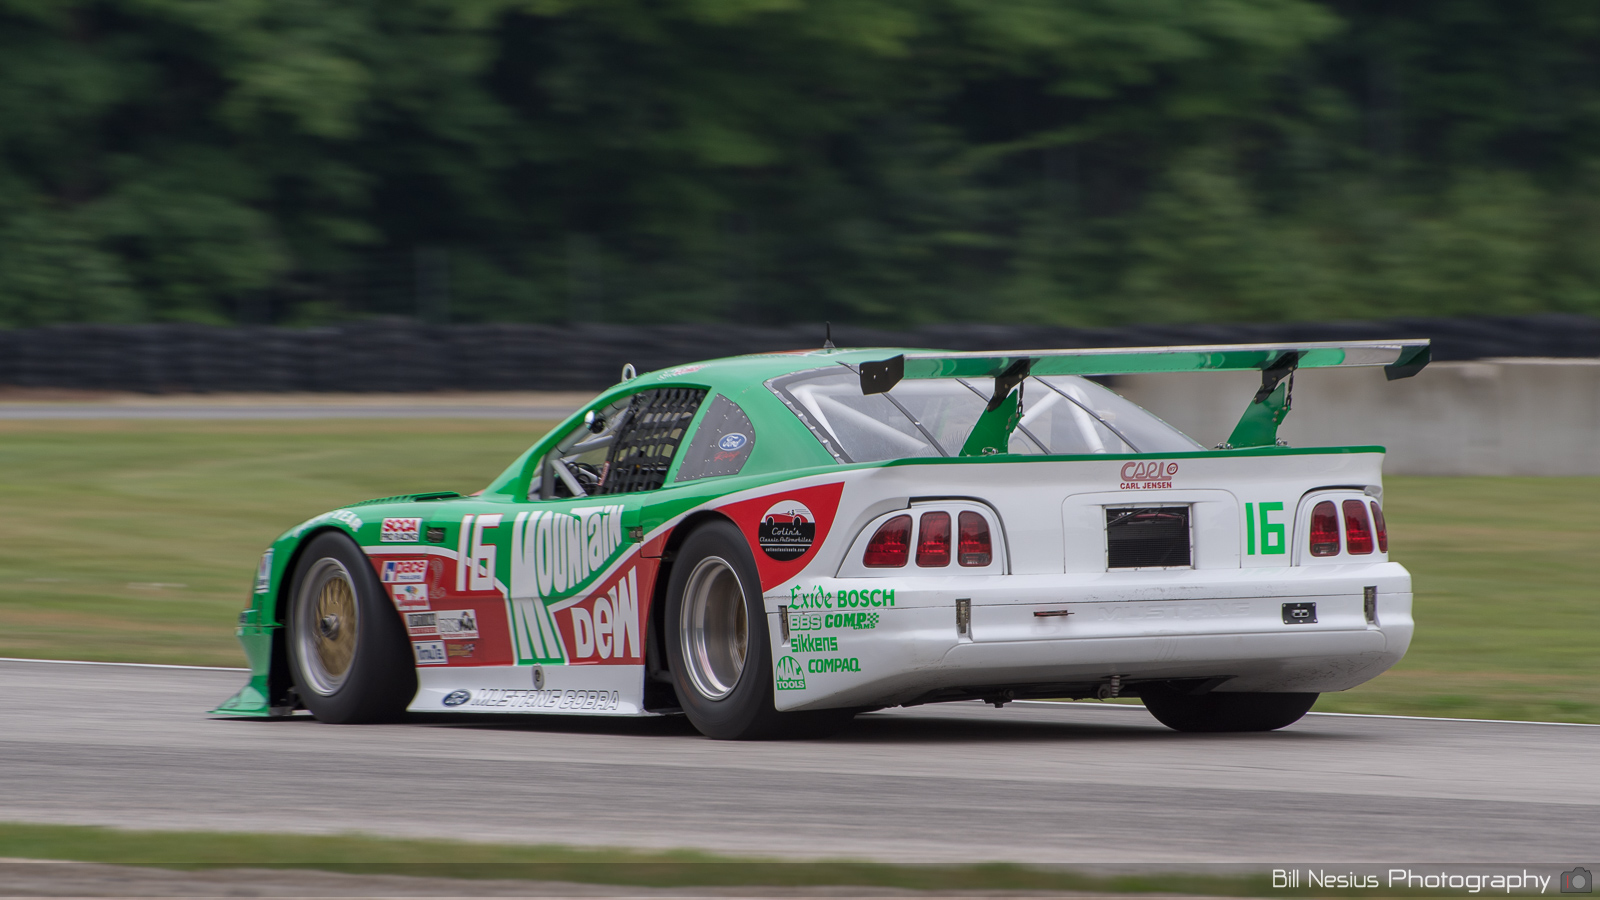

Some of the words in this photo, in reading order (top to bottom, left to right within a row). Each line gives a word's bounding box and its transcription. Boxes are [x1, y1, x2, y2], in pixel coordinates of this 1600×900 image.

[1120, 462, 1172, 481] CARL
[1120, 482, 1140, 490] CARL
[1142, 481, 1172, 489] JENSEN
[384, 519, 418, 532] SCCA
[771, 527, 802, 536] Colin's
[1245, 502, 1286, 555] 16
[456, 513, 503, 591] 16
[788, 584, 832, 610] Exide
[837, 589, 895, 608] BOSCH
[790, 614, 821, 631] BBS
[825, 613, 866, 628] COMP
[790, 634, 838, 653] sikkens
[777, 657, 804, 680] MAC
[808, 658, 861, 673] COMPAQ
[777, 681, 805, 689] TOOLS
[471, 689, 562, 708] MUSTANG
[559, 690, 620, 710] COBRA
